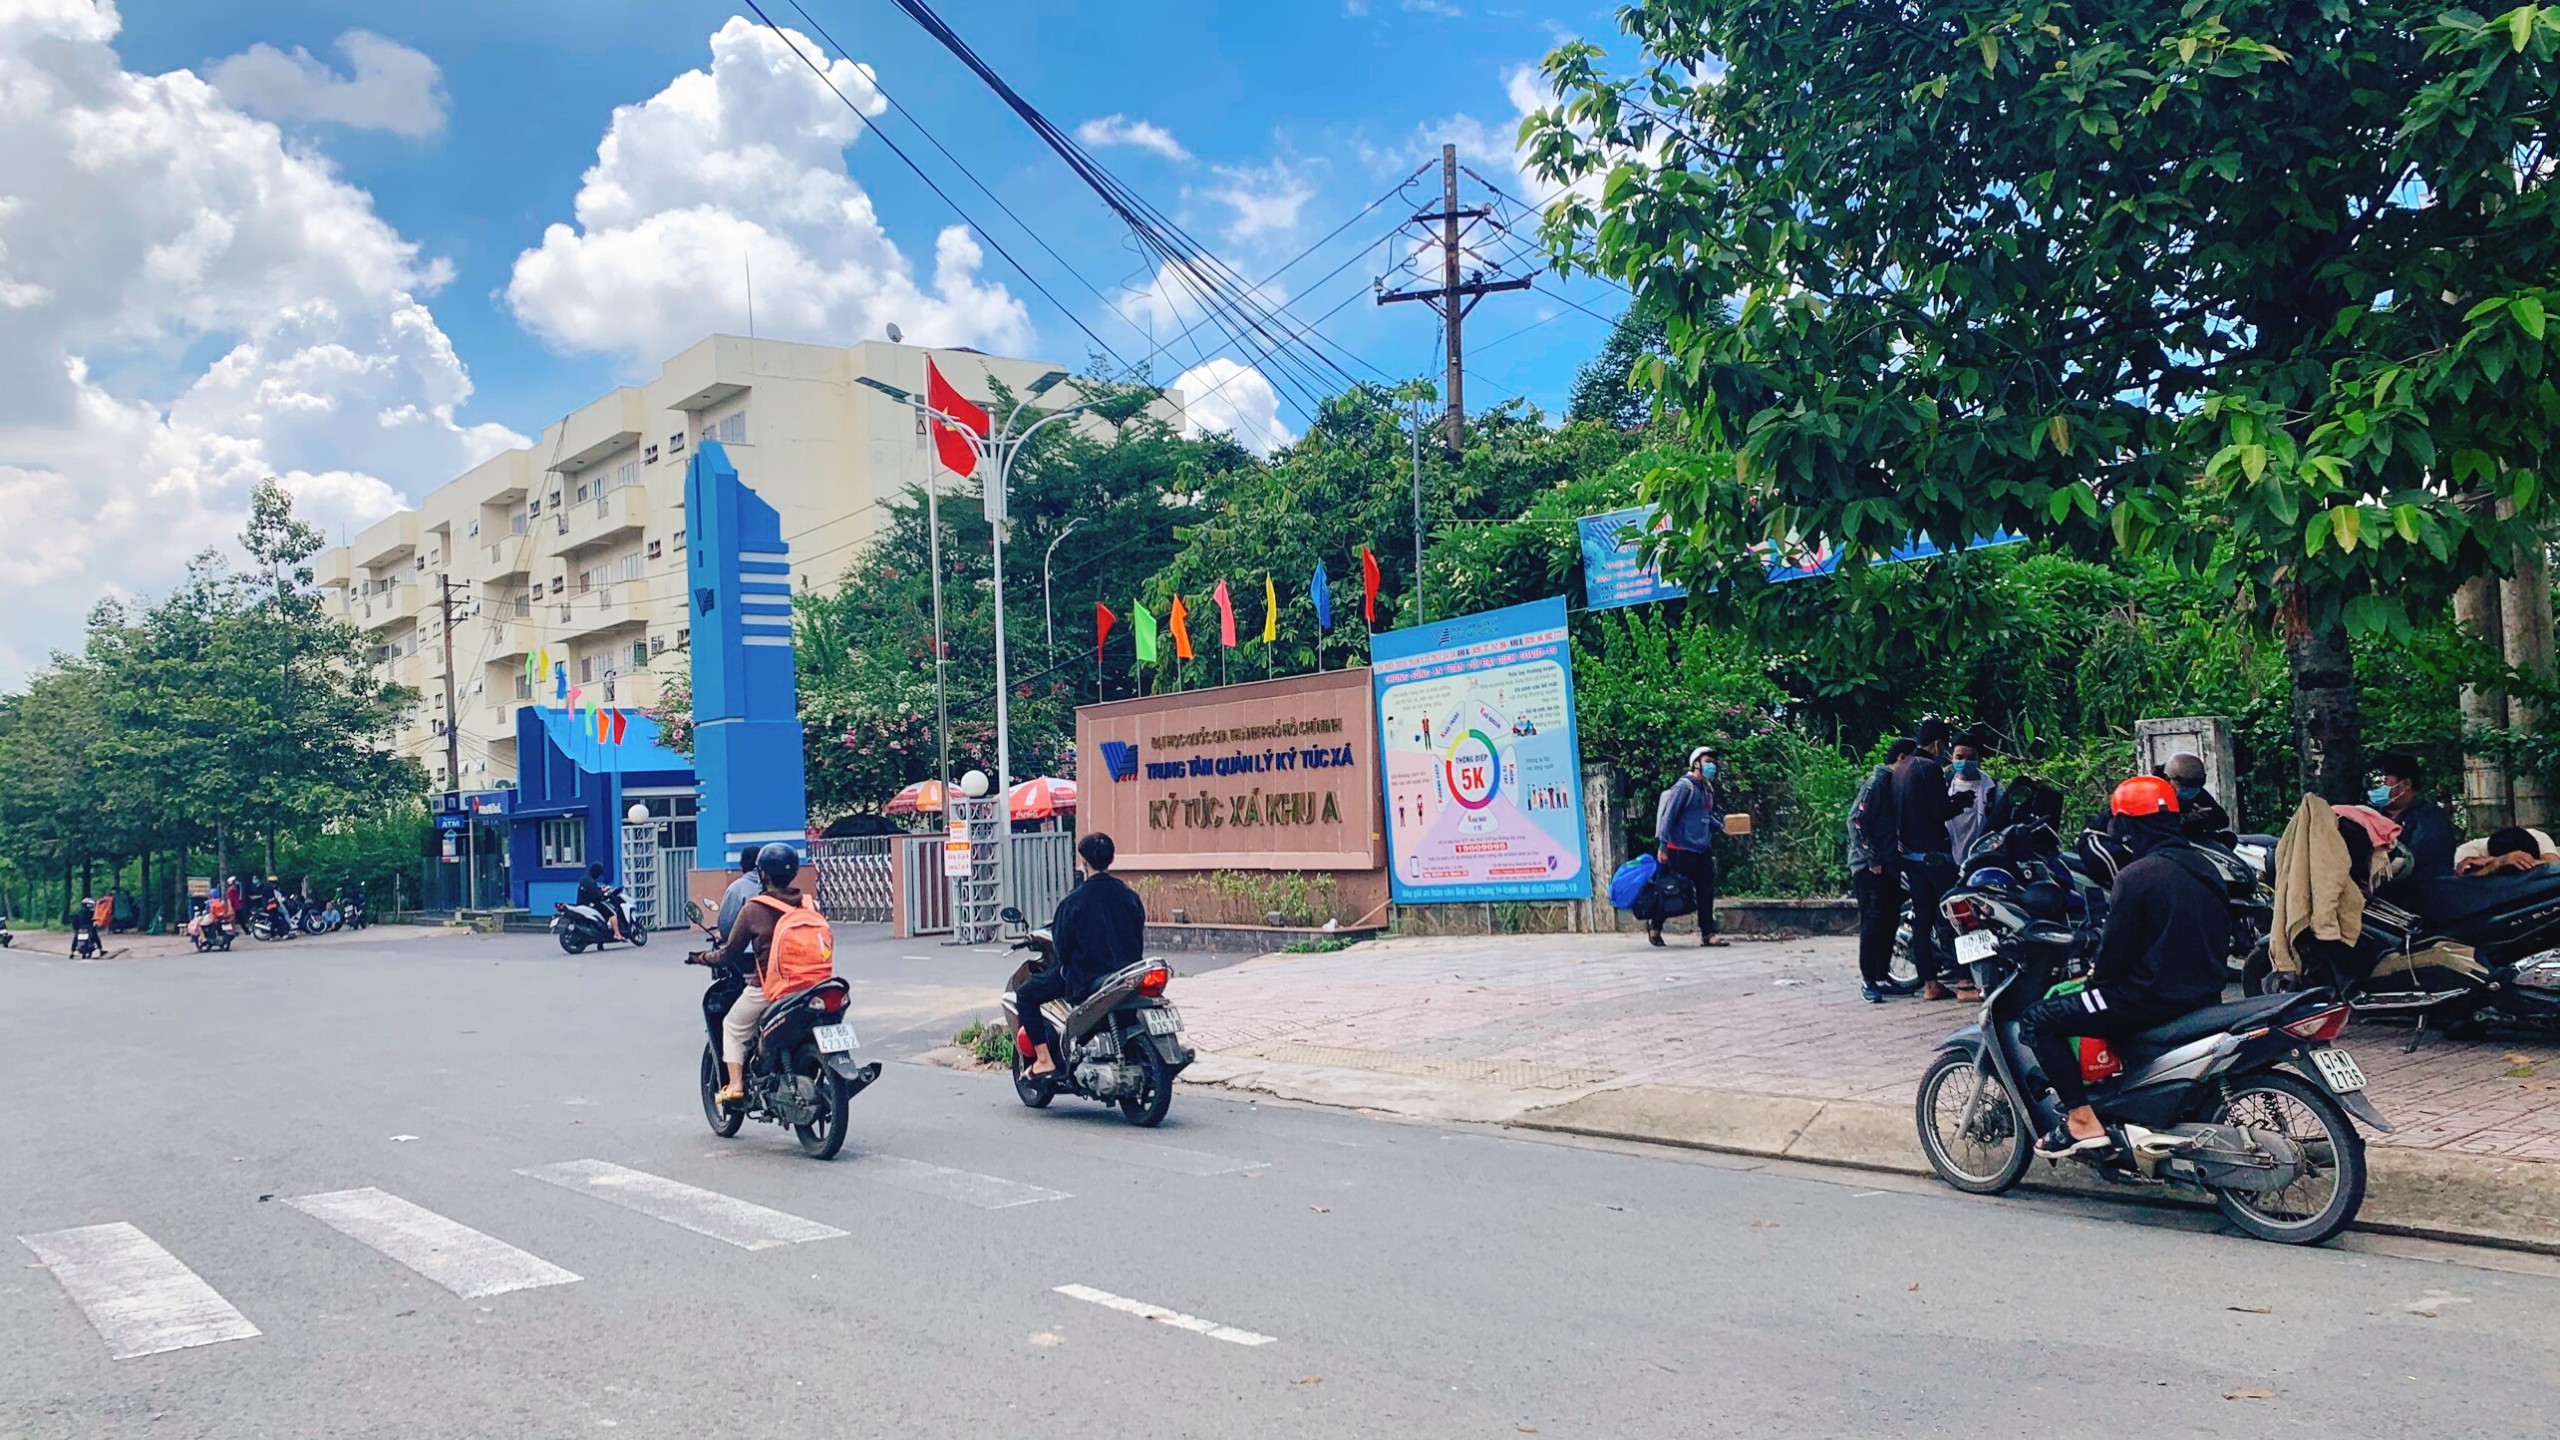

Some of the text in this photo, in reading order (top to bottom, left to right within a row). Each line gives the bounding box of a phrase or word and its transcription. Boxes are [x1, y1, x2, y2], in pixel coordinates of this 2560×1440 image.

[1145, 742, 1355, 780] TRUNG TÂM QUẢN LÝ KÝ TÚC XÁ
[1461, 766, 1486, 791] 5K
[1149, 787, 1343, 829] KÝ TÚC XÁ KHU A
[442, 819, 460, 829] ATM
[2319, 1050, 2351, 1070] 47-N7
[2331, 1068, 2364, 1089] 2736
